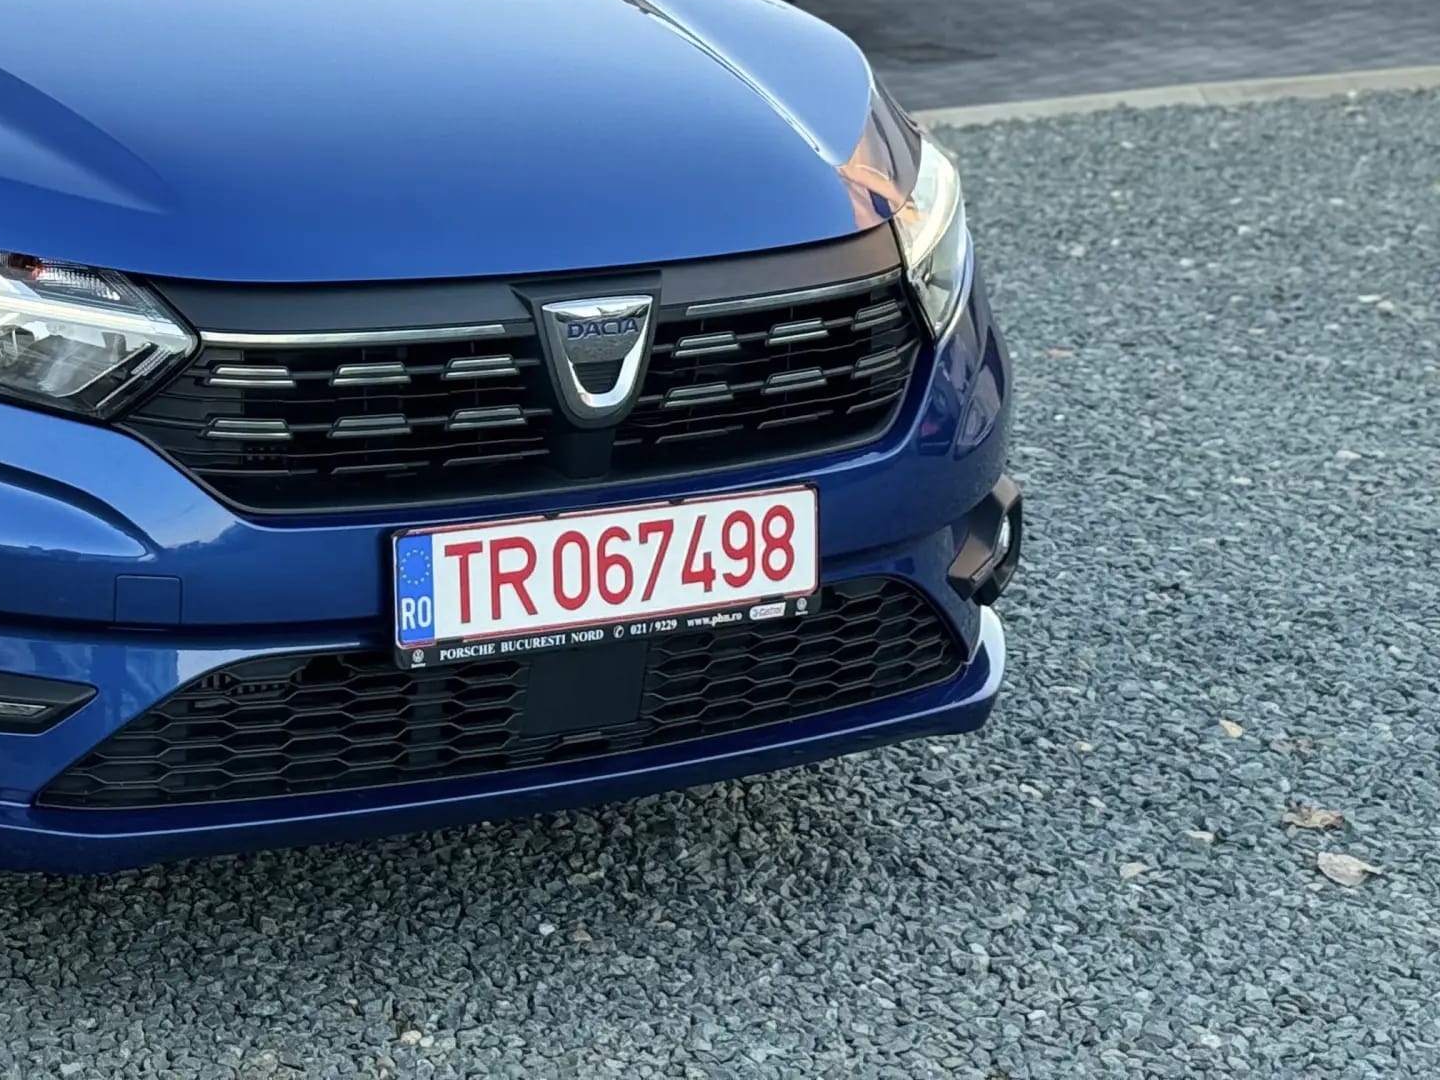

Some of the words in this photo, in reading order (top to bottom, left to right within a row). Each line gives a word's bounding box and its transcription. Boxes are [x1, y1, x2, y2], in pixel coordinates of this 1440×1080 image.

[567, 318, 639, 340] DACIA
[401, 596, 432, 631] RO
[439, 644, 496, 661] PORSCHE
[500, 634, 566, 653] BUCURESTI
[570, 629, 604, 644] NORD
[630, 623, 647, 635] 021
[654, 619, 678, 632] 9229
